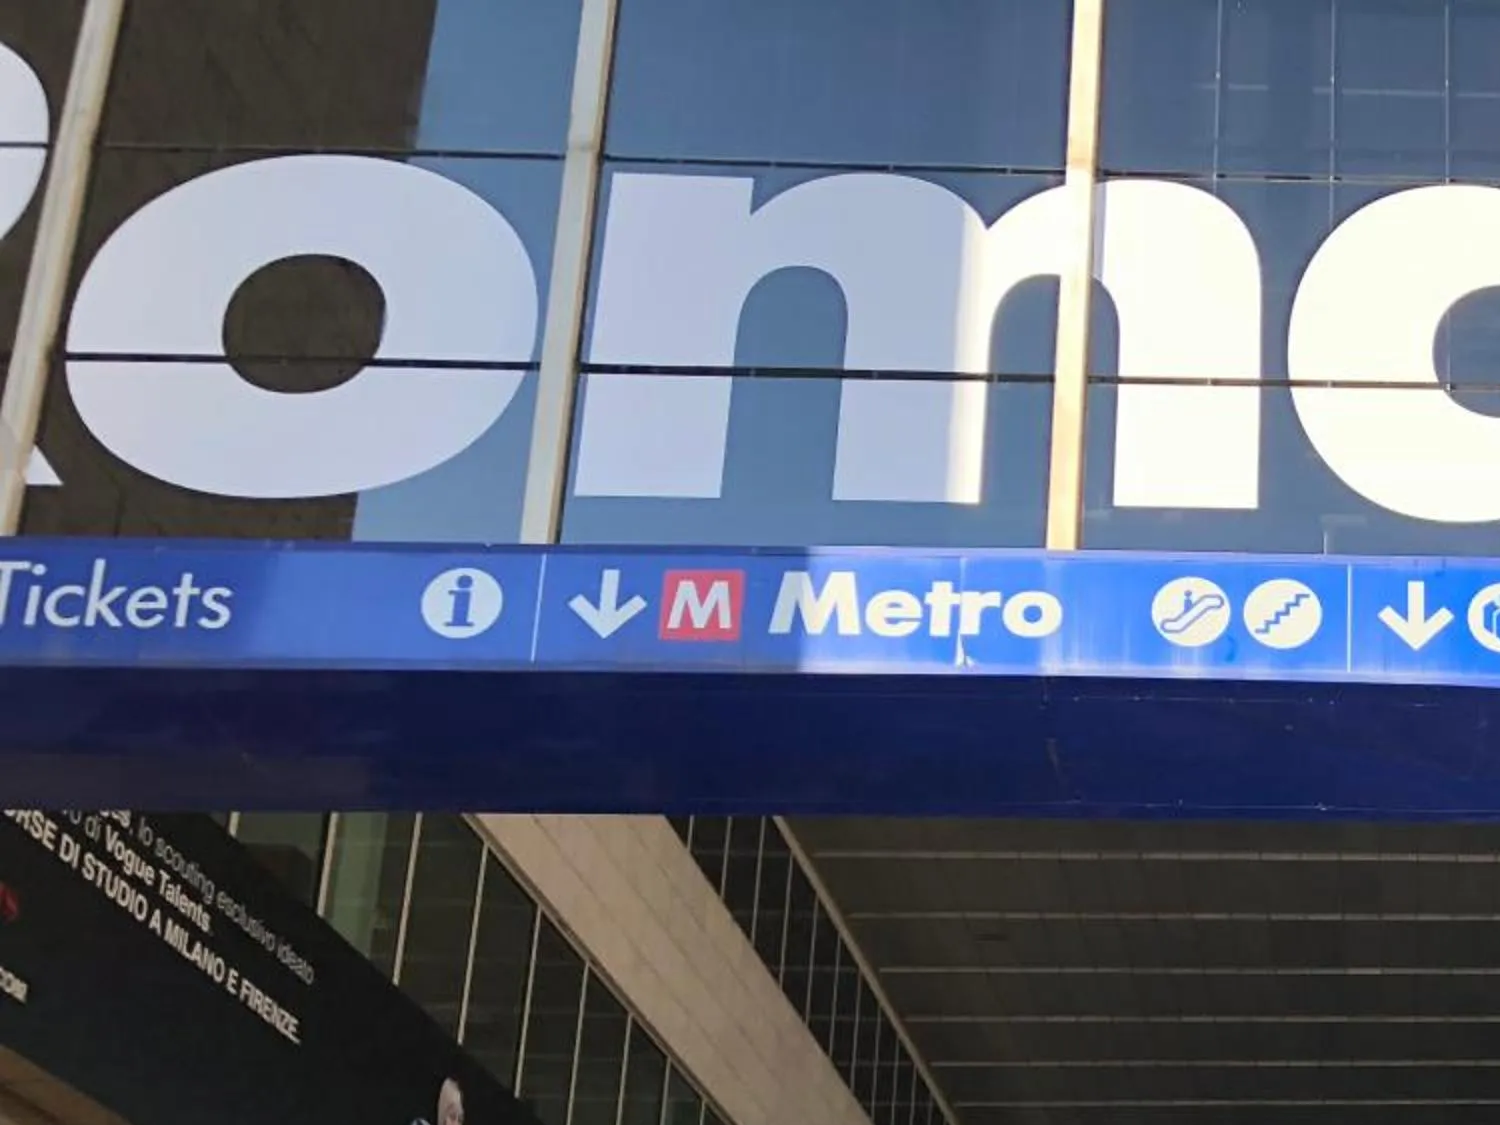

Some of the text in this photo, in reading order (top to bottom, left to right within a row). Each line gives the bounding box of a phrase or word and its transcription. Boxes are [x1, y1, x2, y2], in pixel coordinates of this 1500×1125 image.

[0, 559, 233, 630] Tickets
[768, 571, 1063, 639] Metro
[105, 824, 156, 886] Vogue
[58, 832, 81, 869] DI
[81, 851, 149, 922] STUDIO
[149, 908, 162, 937] A
[164, 917, 225, 983] MILANO
[226, 967, 239, 996] E
